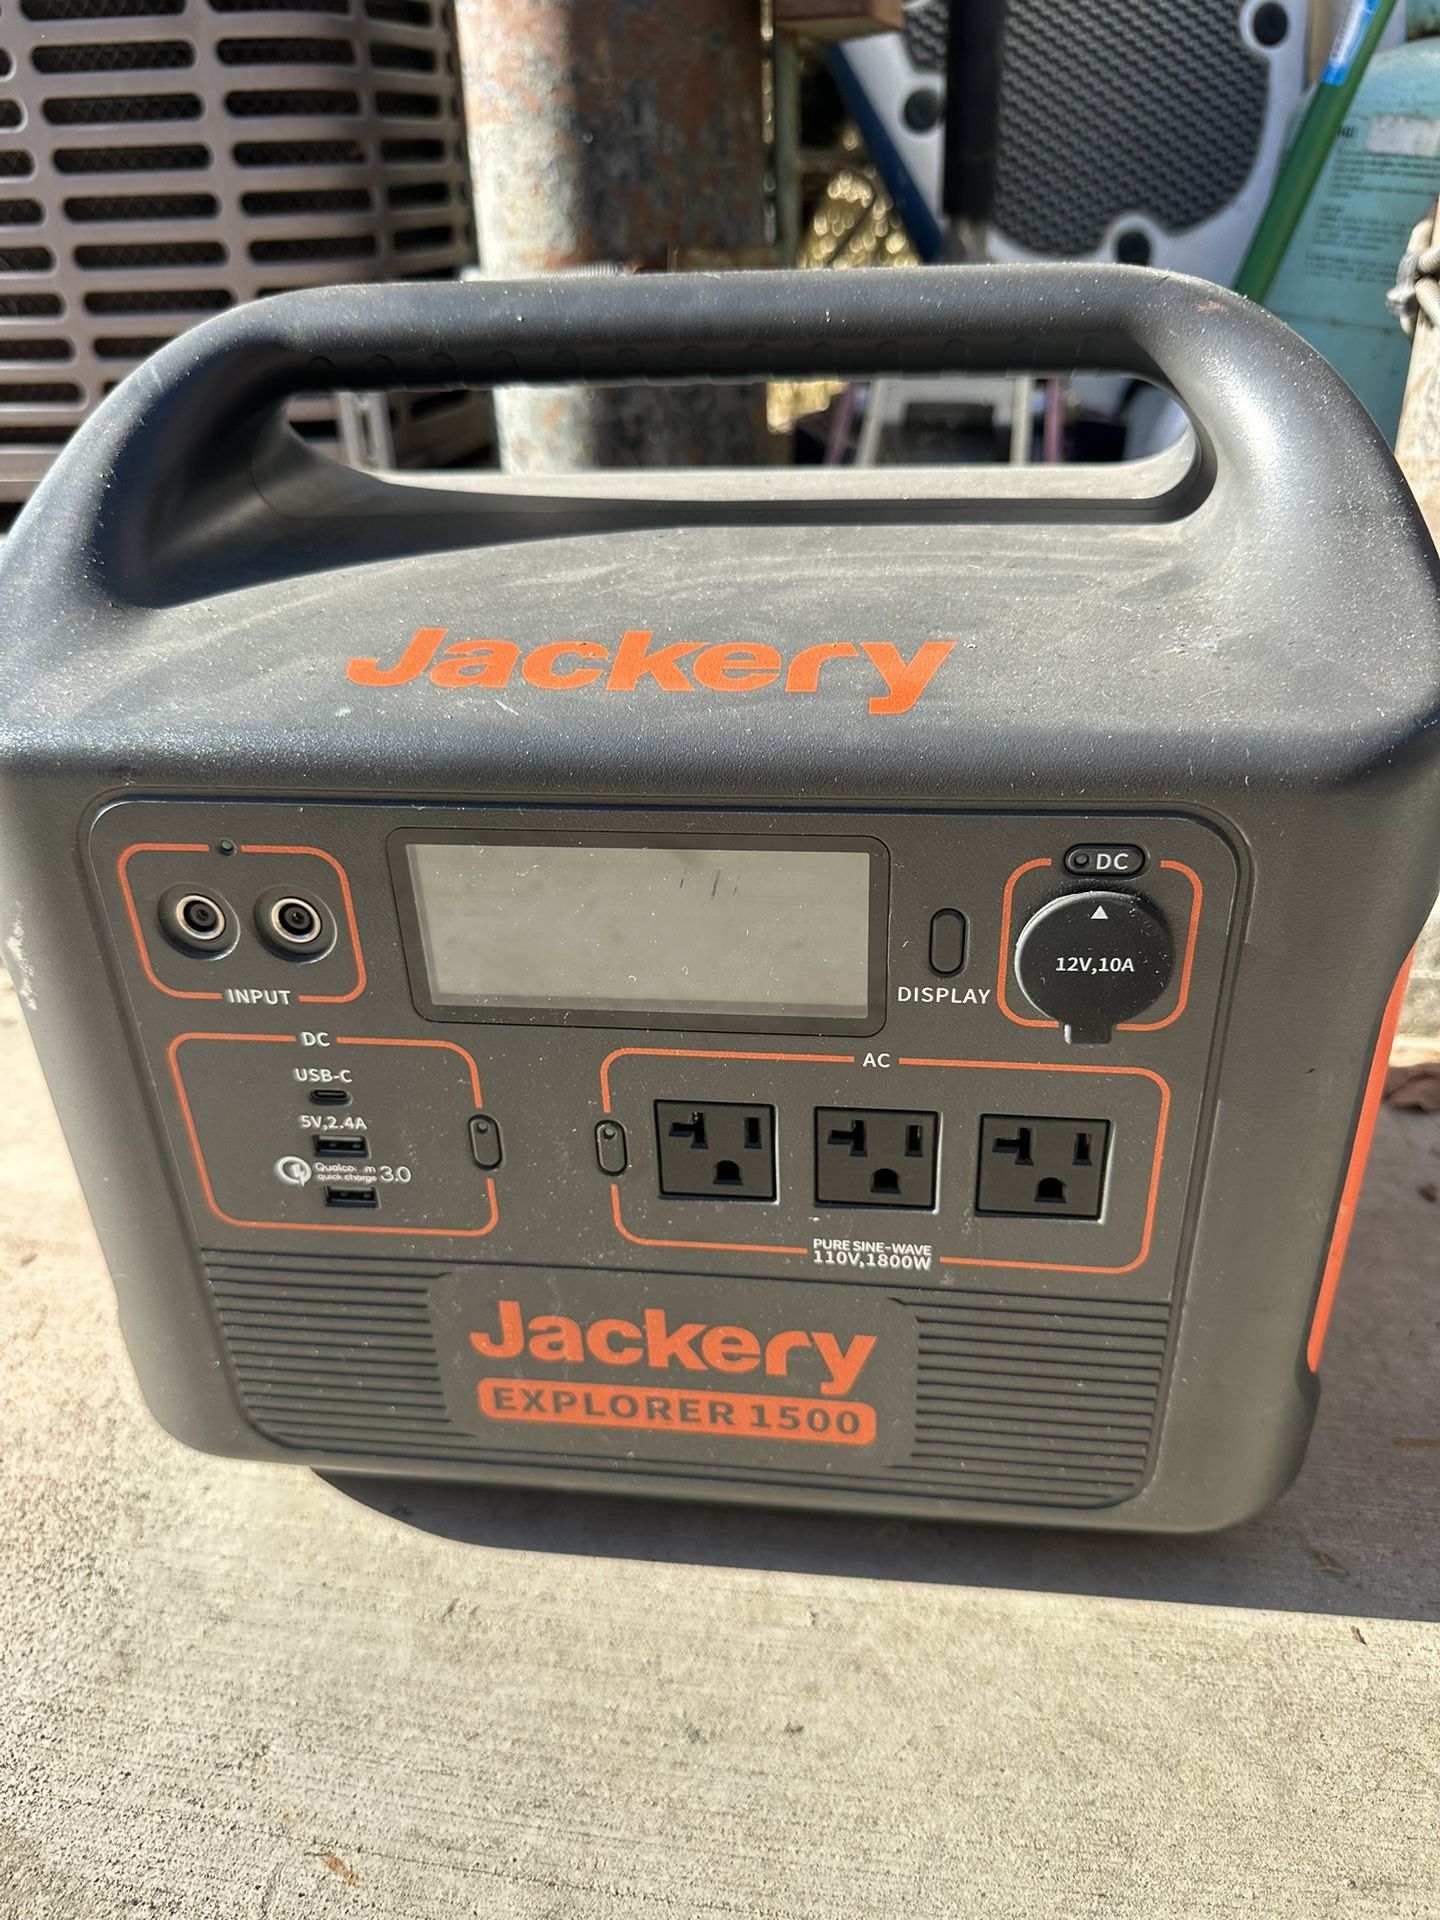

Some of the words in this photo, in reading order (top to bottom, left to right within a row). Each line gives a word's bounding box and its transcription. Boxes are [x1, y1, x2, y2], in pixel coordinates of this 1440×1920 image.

[345, 627, 957, 715] Jackery
[1095, 853, 1130, 870] DC
[1055, 956, 1136, 975] 12V,10A
[227, 988, 291, 1005] INPUT
[897, 986, 991, 1005] DISPLAY
[302, 1031, 331, 1047] DC
[862, 1052, 891, 1068] AC
[294, 1068, 353, 1083] USB-C
[301, 1115, 368, 1131] 5V,2.4A
[317, 1173, 343, 1182] quick
[344, 1173, 378, 1183] charge
[380, 1165, 412, 1183] 3.0
[813, 1238, 851, 1250] PURE
[852, 1240, 932, 1256] SINE-WAVE
[813, 1250, 931, 1270] 110V,1800W
[469, 1300, 877, 1396] Jackery
[492, 1386, 736, 1426] EXPLORER
[750, 1404, 860, 1435] 1500
